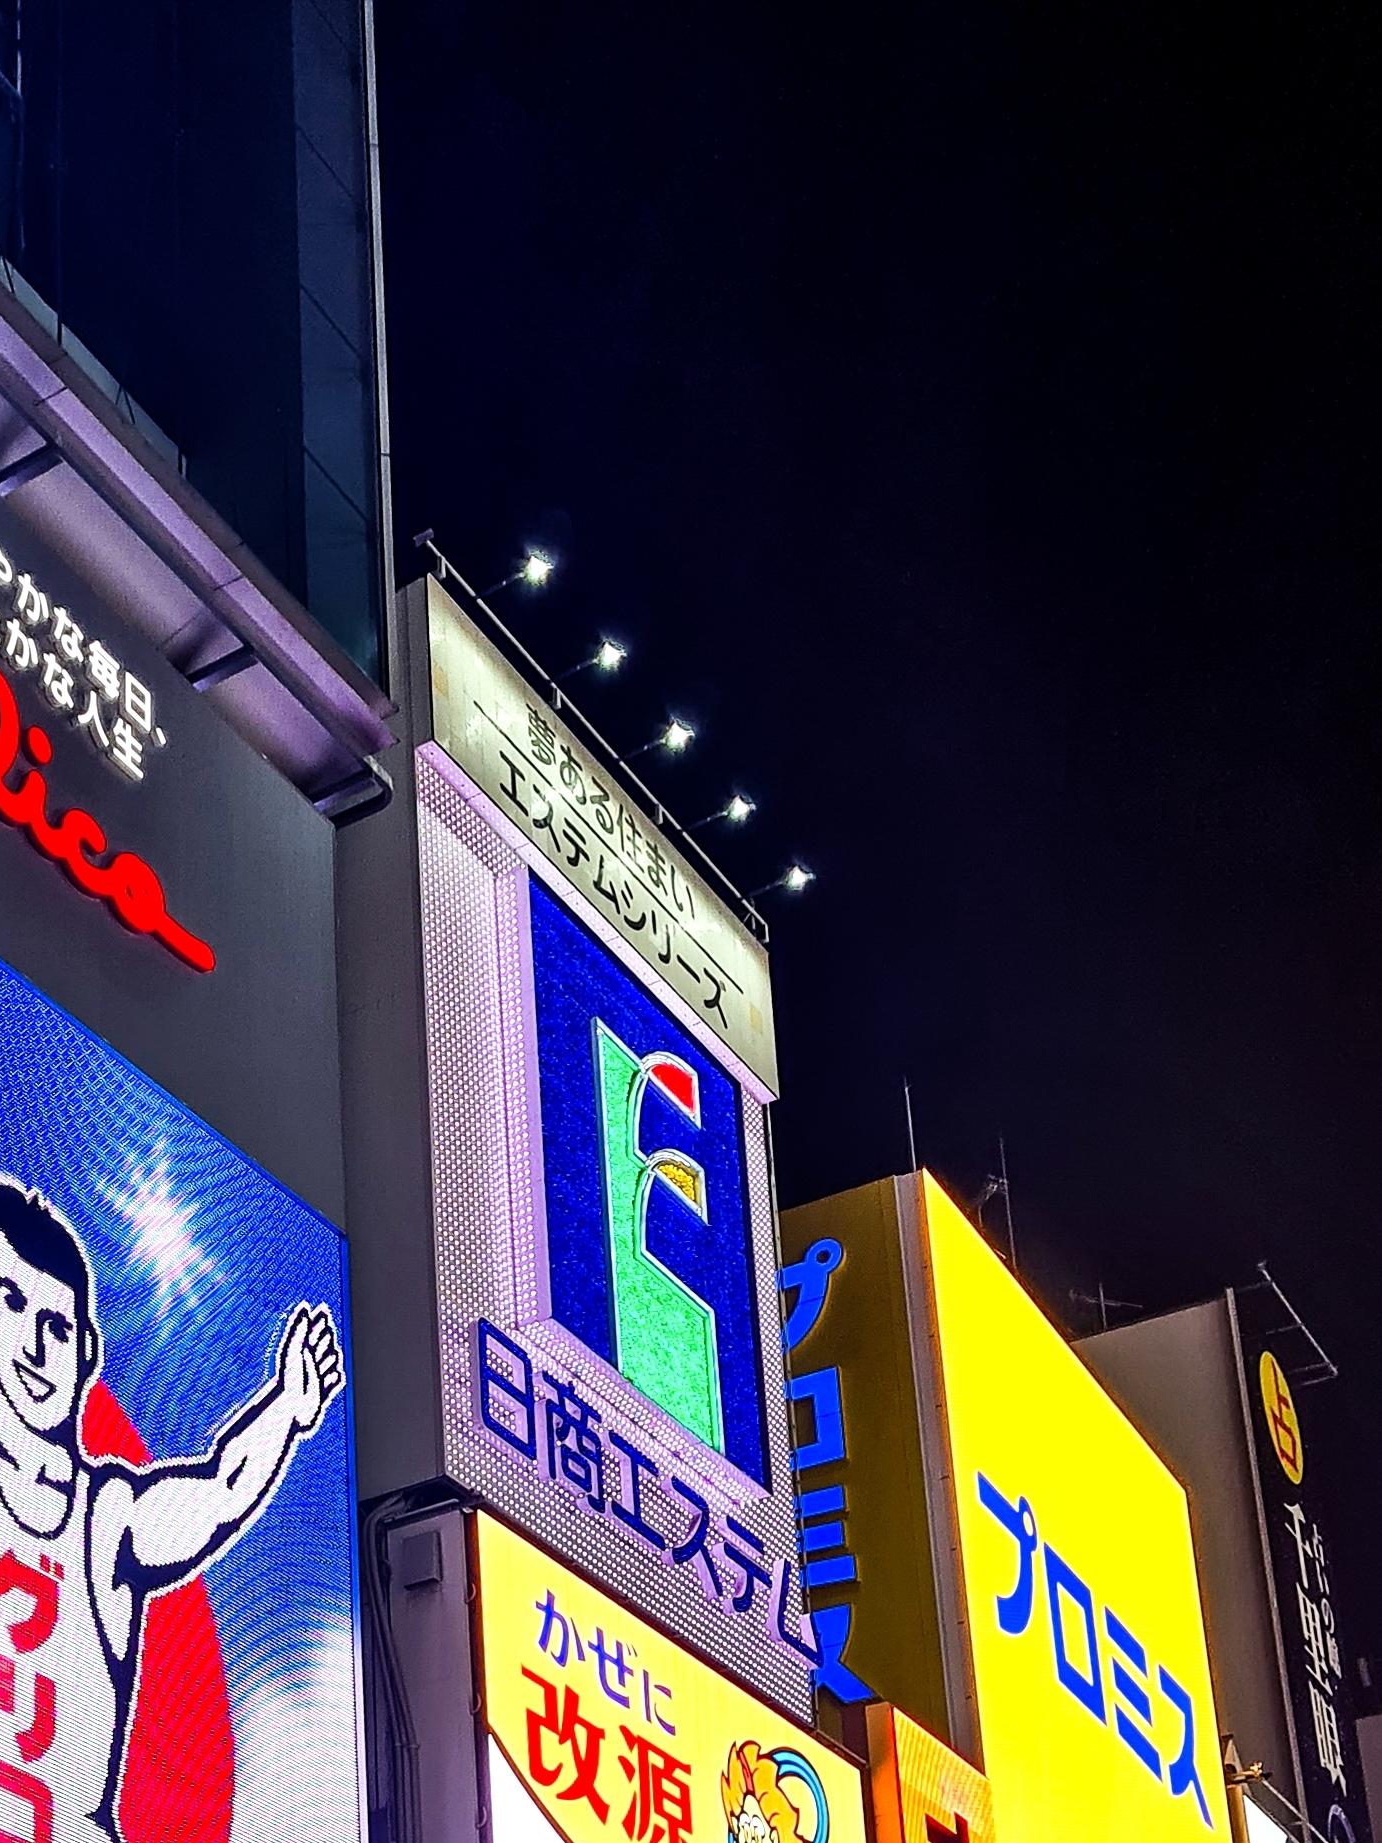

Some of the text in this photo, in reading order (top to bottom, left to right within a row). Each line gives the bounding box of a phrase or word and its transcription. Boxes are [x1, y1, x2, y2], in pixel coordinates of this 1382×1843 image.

[534, 1587, 677, 1737] かぜに
[976, 1470, 1216, 1832] プロミス
[1284, 1501, 1348, 1798] 千里眼
